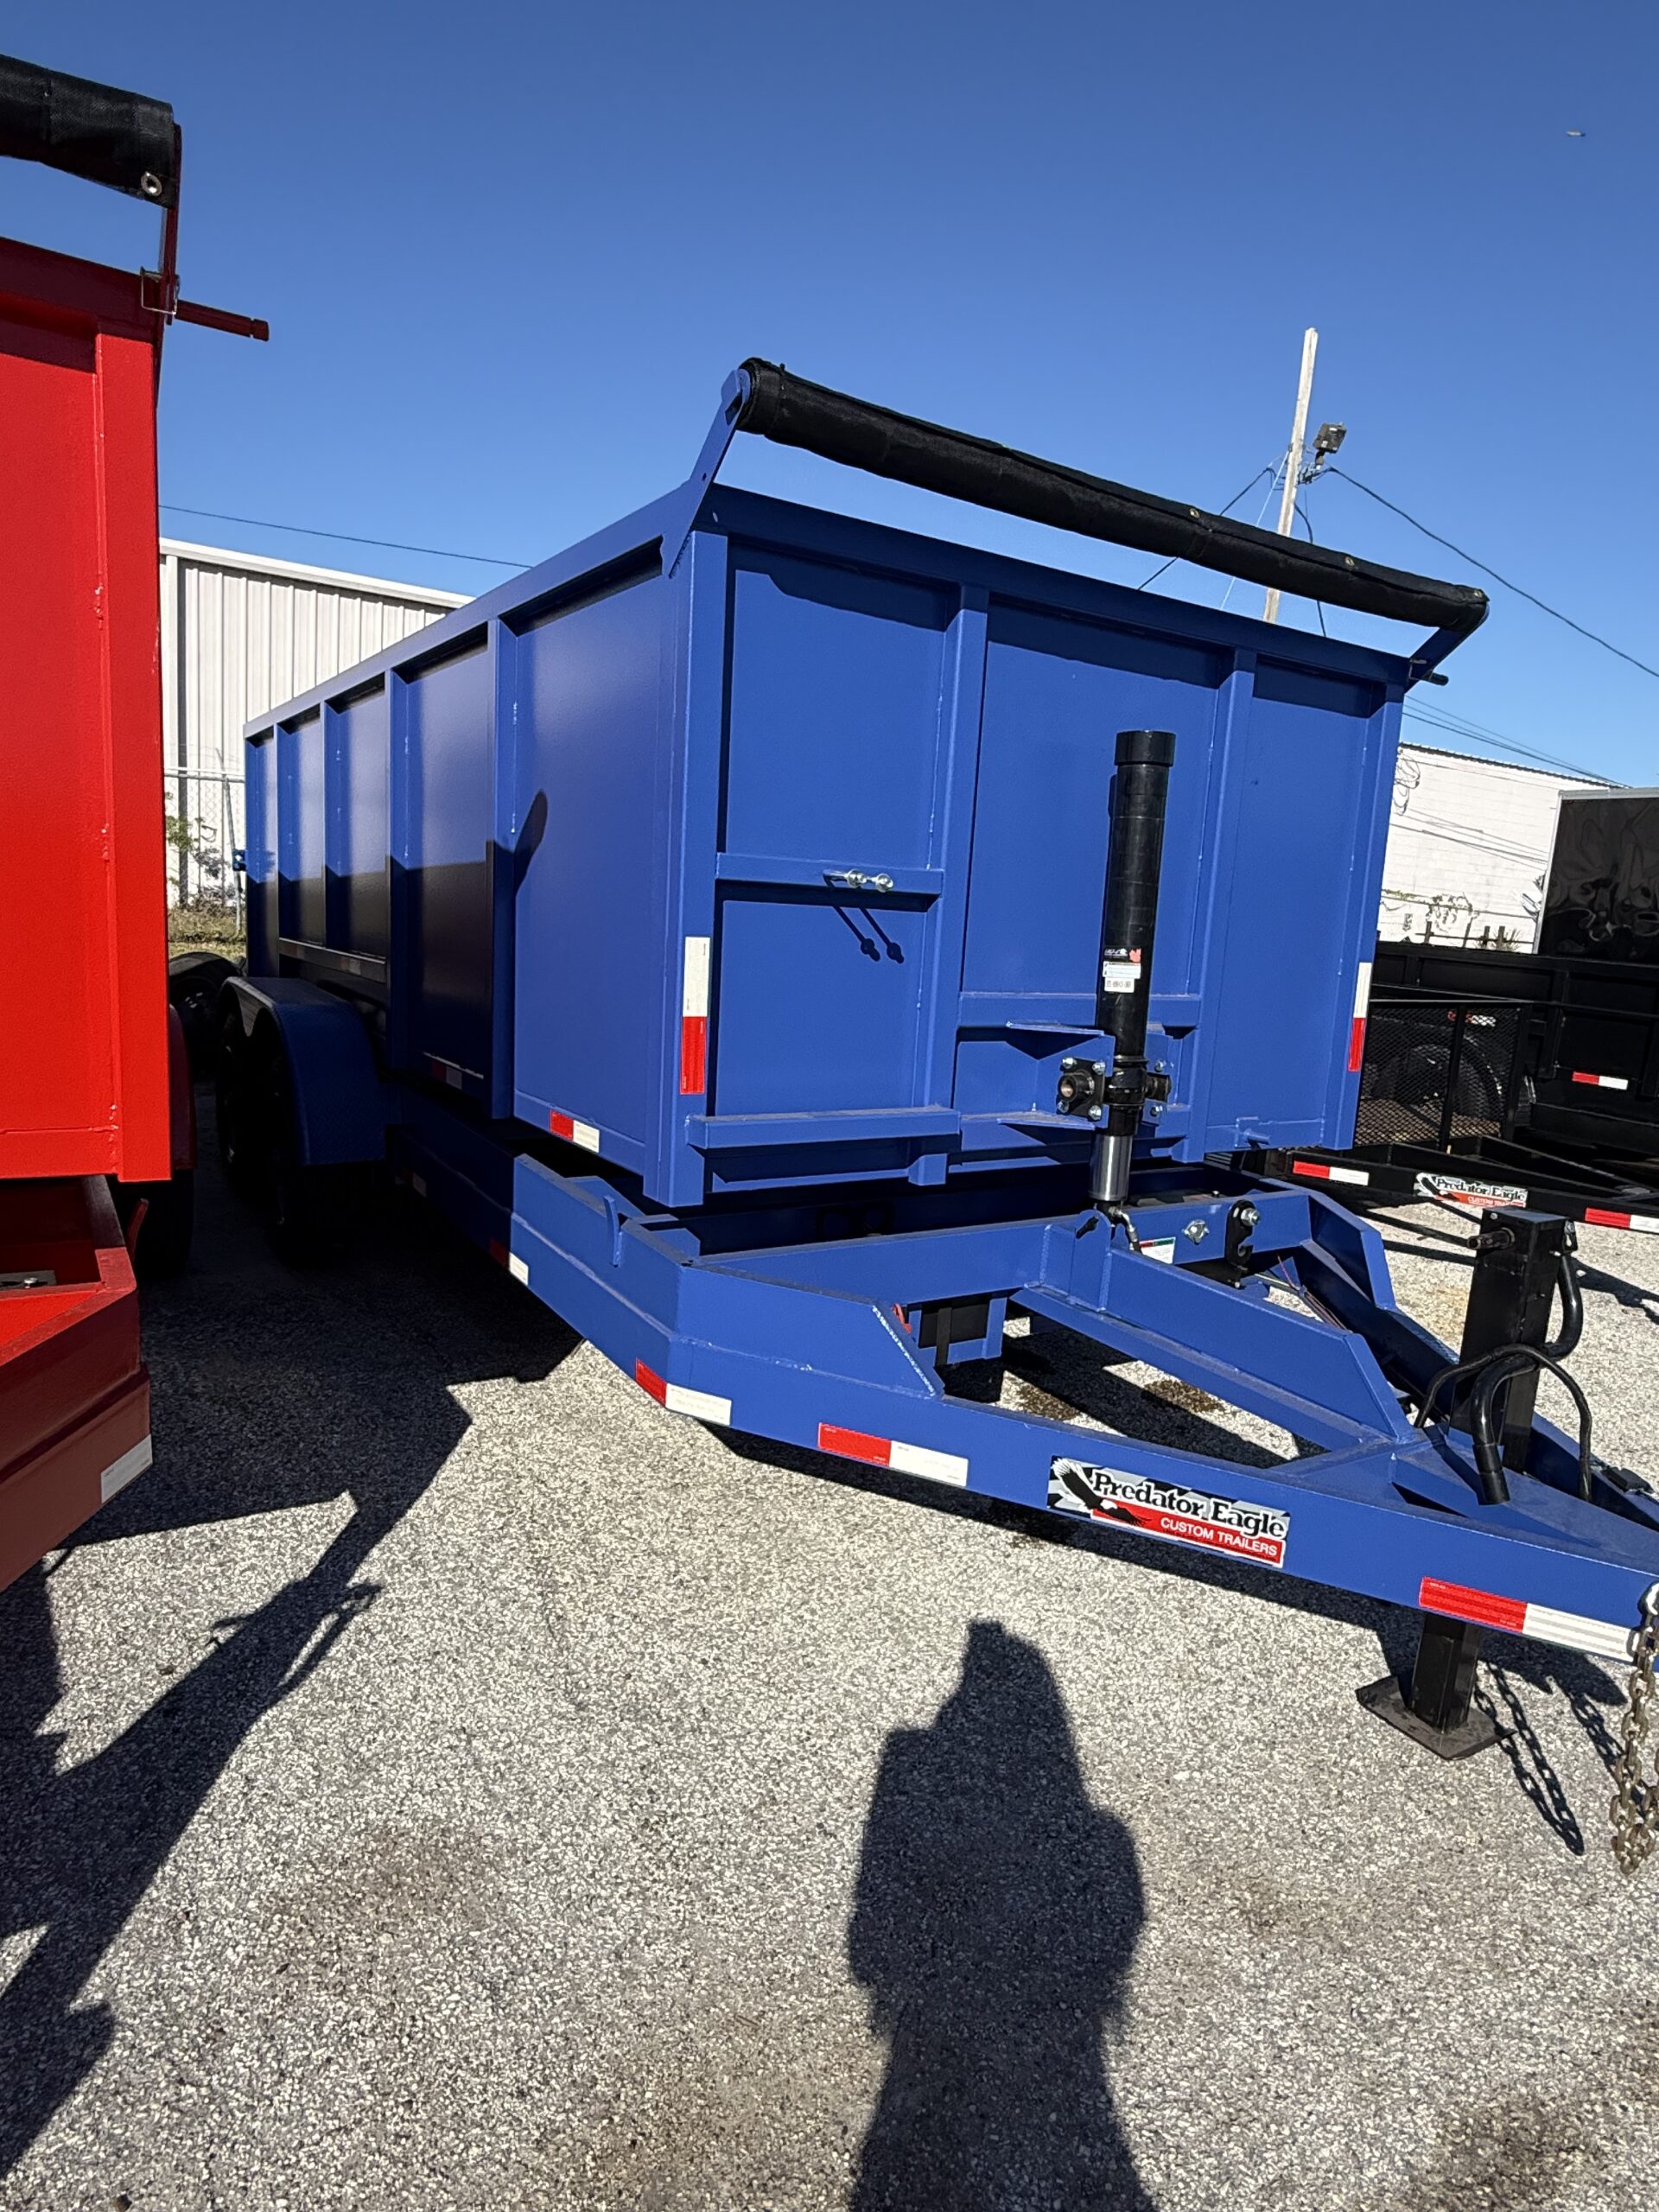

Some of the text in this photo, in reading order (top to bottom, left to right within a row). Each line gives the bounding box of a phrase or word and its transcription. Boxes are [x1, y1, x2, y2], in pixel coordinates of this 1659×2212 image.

[1437, 1179, 1525, 1202] Predator Eagle
[1093, 1472, 1285, 1537] Predator Eagle
[1160, 1517, 1278, 1556] CUSTOM TRAILERS
